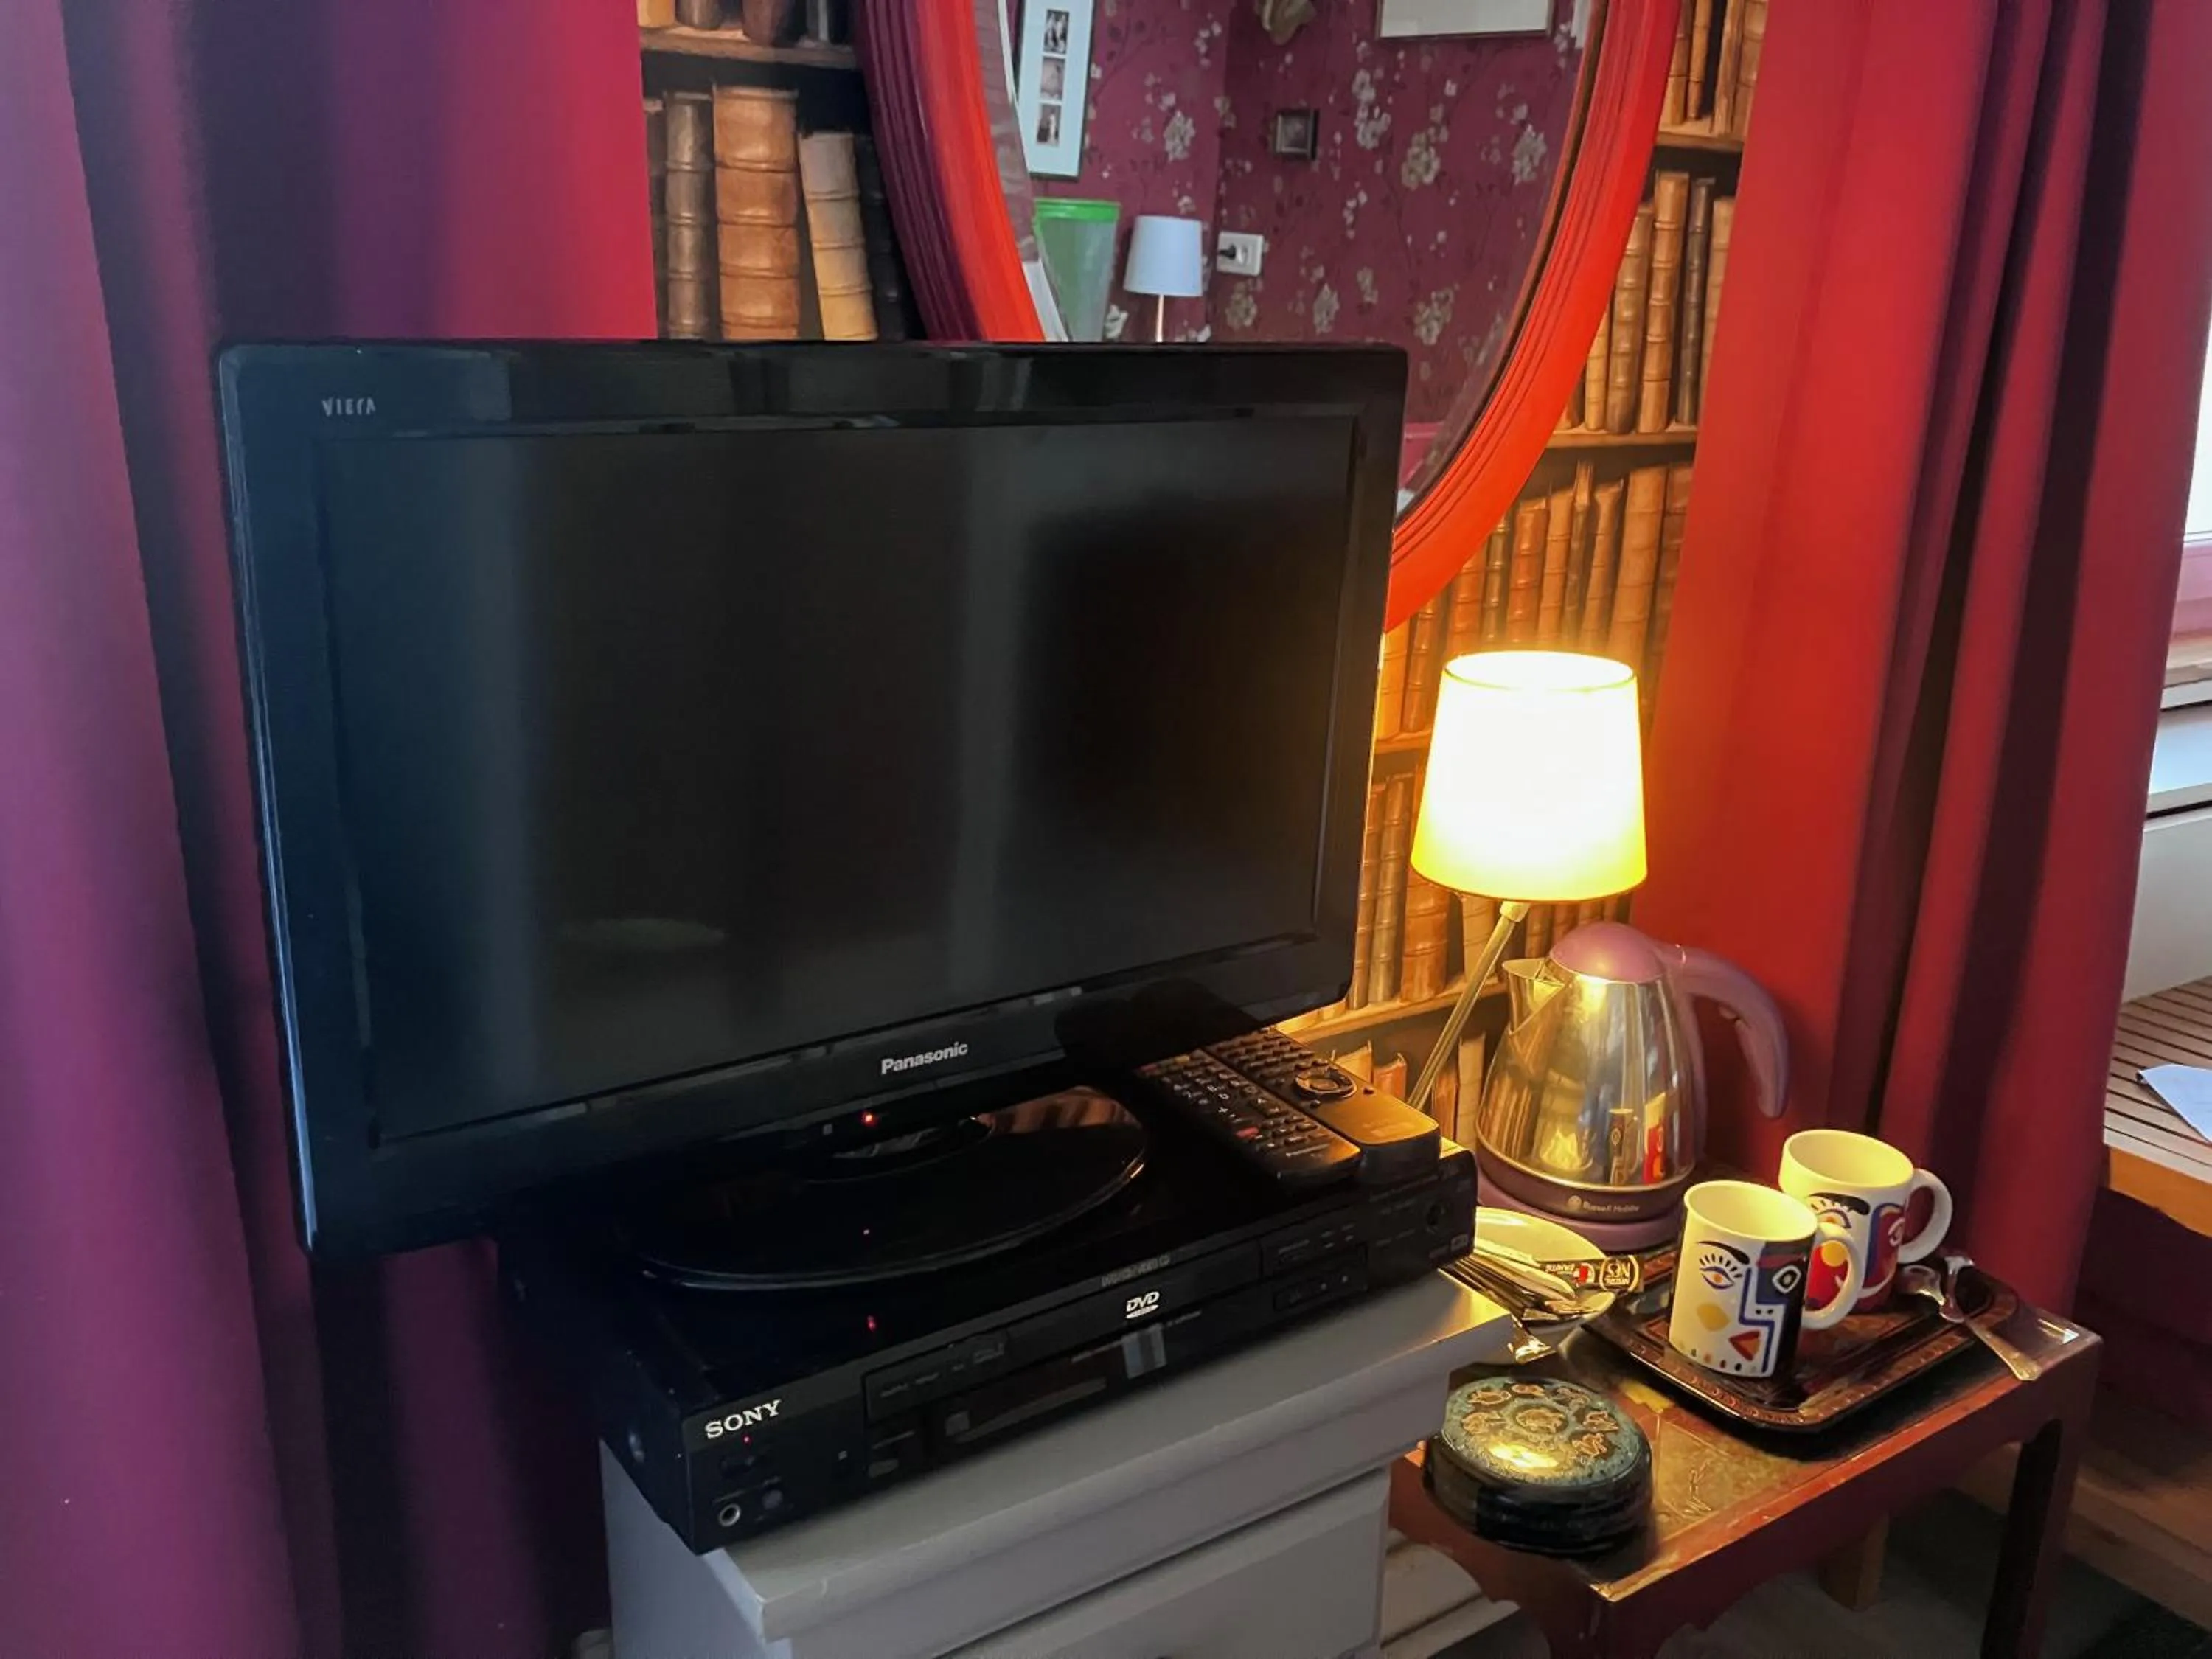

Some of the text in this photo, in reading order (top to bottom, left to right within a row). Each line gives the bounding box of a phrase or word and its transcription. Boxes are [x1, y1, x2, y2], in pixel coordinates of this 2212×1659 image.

[881, 1041, 968, 1074] Panasonic
[1126, 1291, 1160, 1312] DVD
[705, 1399, 781, 1439] SONY
